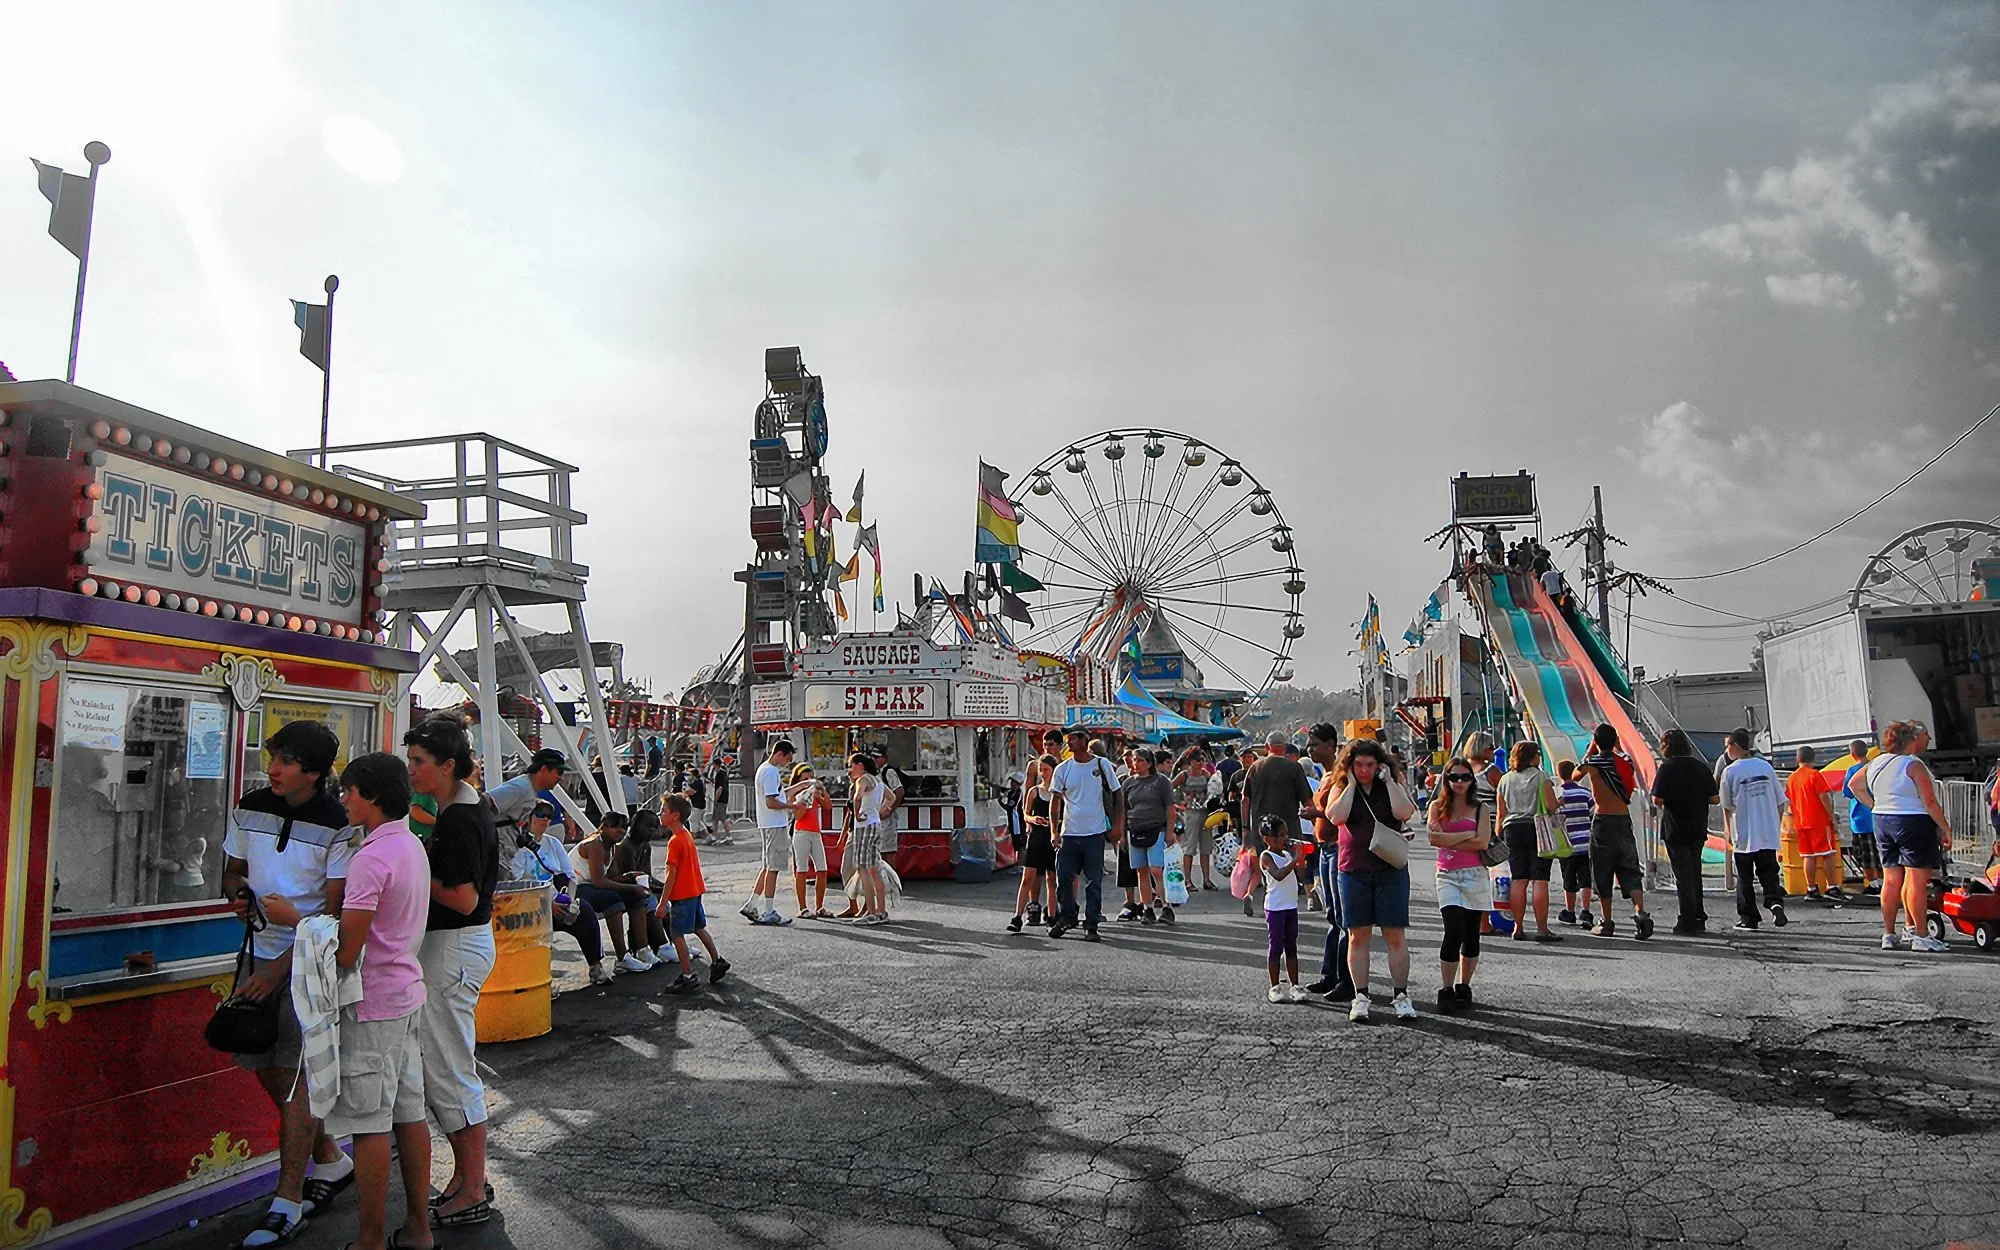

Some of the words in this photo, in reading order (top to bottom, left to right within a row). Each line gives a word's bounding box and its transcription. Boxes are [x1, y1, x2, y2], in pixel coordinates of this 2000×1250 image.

[102, 471, 356, 607] TICKETS
[843, 644, 920, 667] SAUSAGE
[844, 686, 925, 711] STEAK
